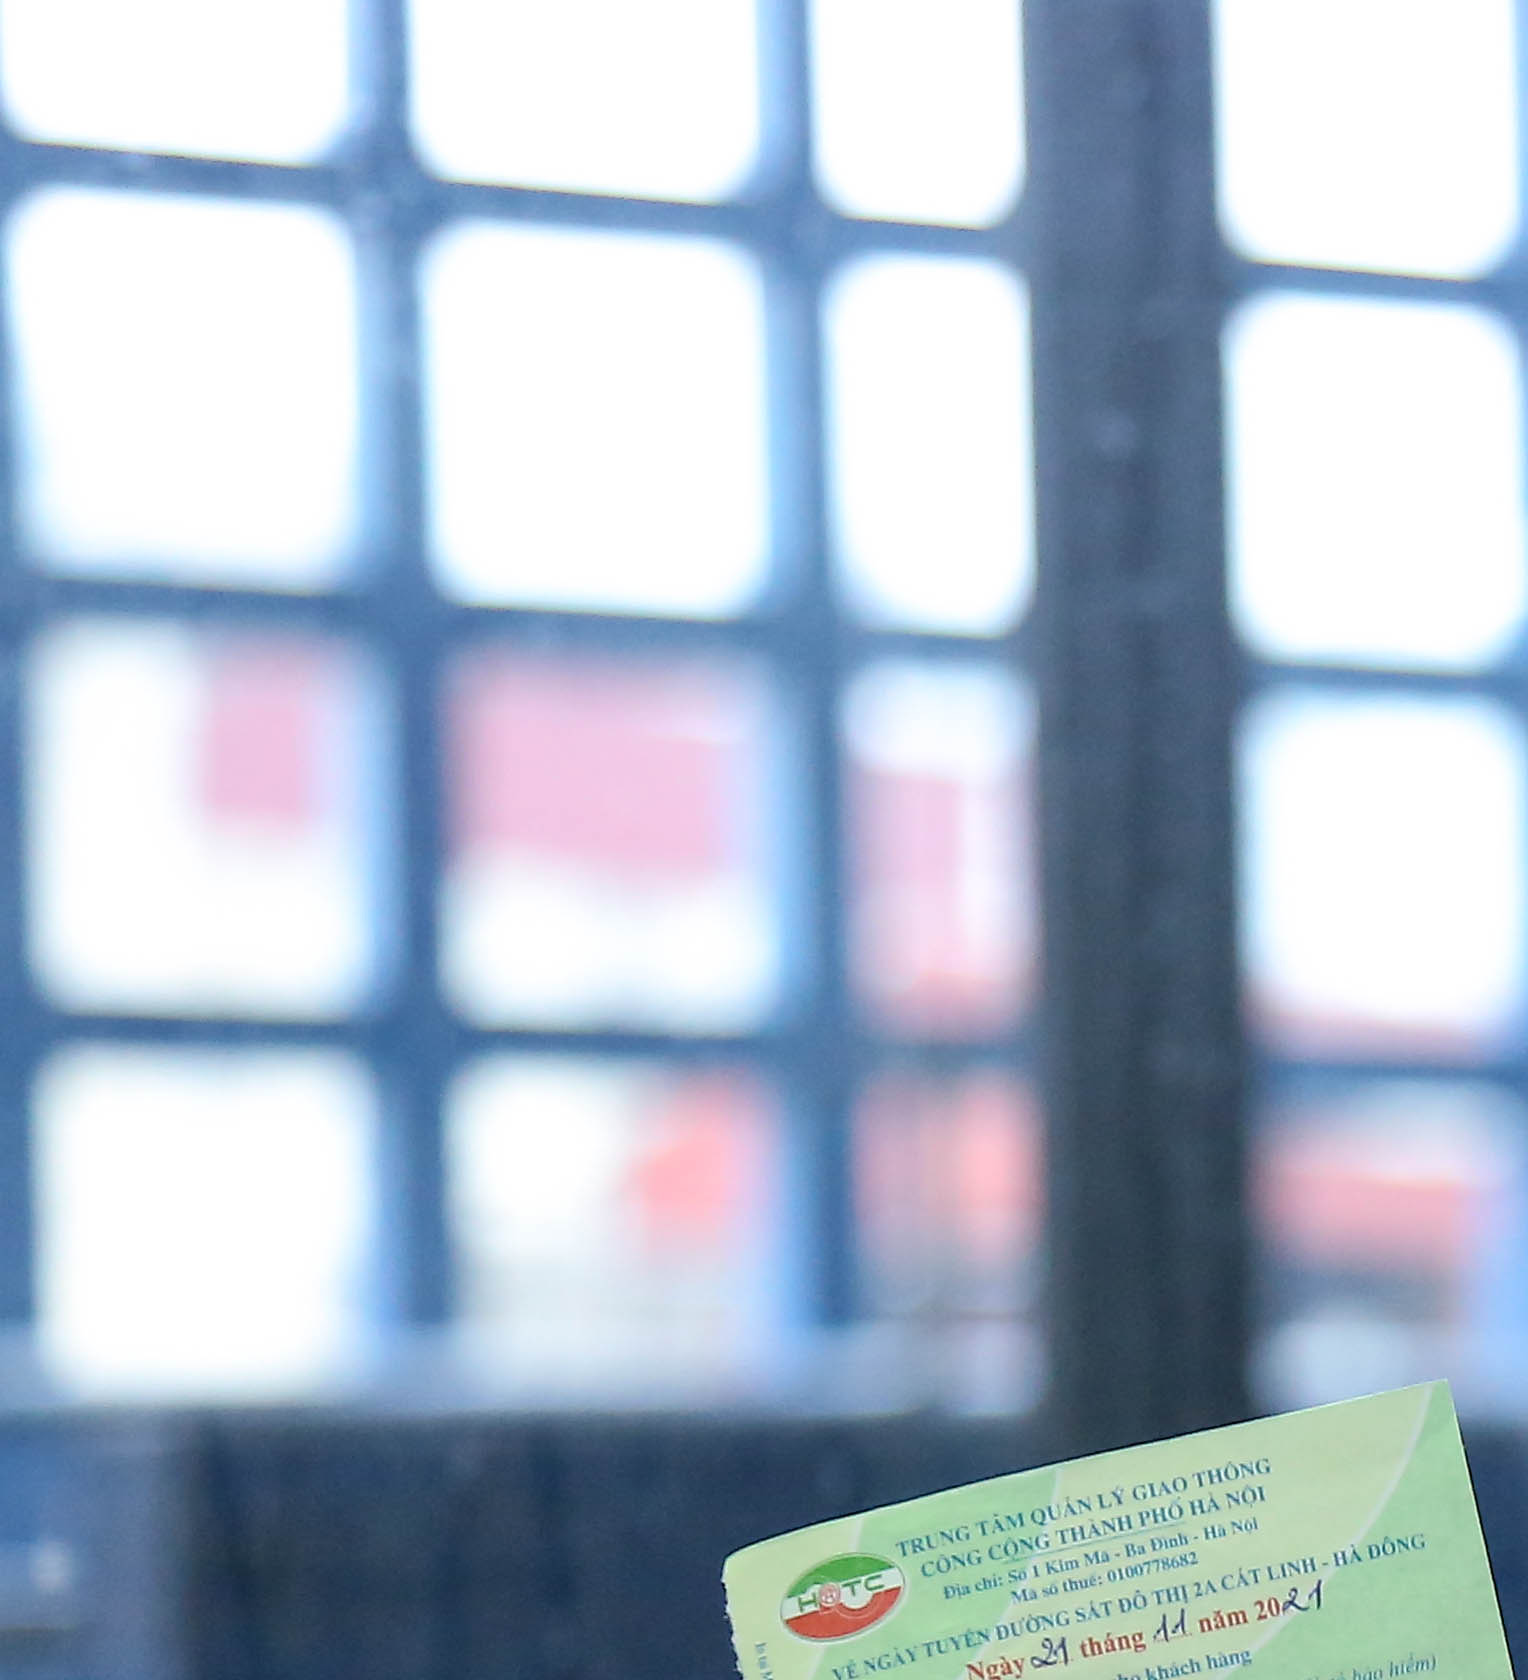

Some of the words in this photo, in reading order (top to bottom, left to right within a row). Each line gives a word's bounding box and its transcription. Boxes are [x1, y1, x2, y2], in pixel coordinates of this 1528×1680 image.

[895, 1525, 970, 1558] TRUNG
[975, 1511, 1025, 1537] TÂM
[1030, 1495, 1092, 1527] QUẢN
[1096, 1486, 1124, 1510] LÝ
[1131, 1475, 1188, 1501] GIAO
[1191, 1457, 1271, 1488] THÔNG
[920, 1548, 982, 1578] CÔNG
[987, 1532, 1050, 1562] CỘNG
[1055, 1513, 1133, 1545] THÀNH
[1137, 1495, 1184, 1524] PHỐ
[1189, 1494, 1221, 1516] HÀ
[1225, 1484, 1266, 1509] NỘI
[943, 1582, 971, 1600] Địa
[1007, 1568, 1028, 1584] Số
[1032, 1563, 1040, 1578] 1
[1045, 1558, 1080, 1576] Kim
[1124, 1542, 1147, 1558] Ba
[1149, 1531, 1189, 1552] Đình
[1203, 1524, 1227, 1541] Hà
[1230, 1515, 1259, 1535] Nội
[1062, 1574, 1103, 1593] thuế:
[1106, 1550, 1199, 1582] 0100778682
[863, 1644, 918, 1675] NGÀY
[921, 1627, 991, 1658] TUYẾN
[995, 1609, 1070, 1641] ĐƯỜNG
[1074, 1598, 1113, 1623] SẮT
[1117, 1588, 1148, 1614] ĐÔ
[1151, 1583, 1189, 1606] THỊ
[1193, 1578, 1218, 1598] 2A
[1220, 1566, 1261, 1591] CÁT
[1266, 1556, 1317, 1581] LINH
[1333, 1542, 1363, 1567] HÀ
[1367, 1532, 1426, 1560] ĐÔNG
[1030, 1635, 1069, 1669] 21
[1079, 1630, 1147, 1659] tháng
[1152, 1606, 1187, 1643] 11
[1198, 1608, 1249, 1633] năm
[1205, 1649, 1253, 1670] hàng
